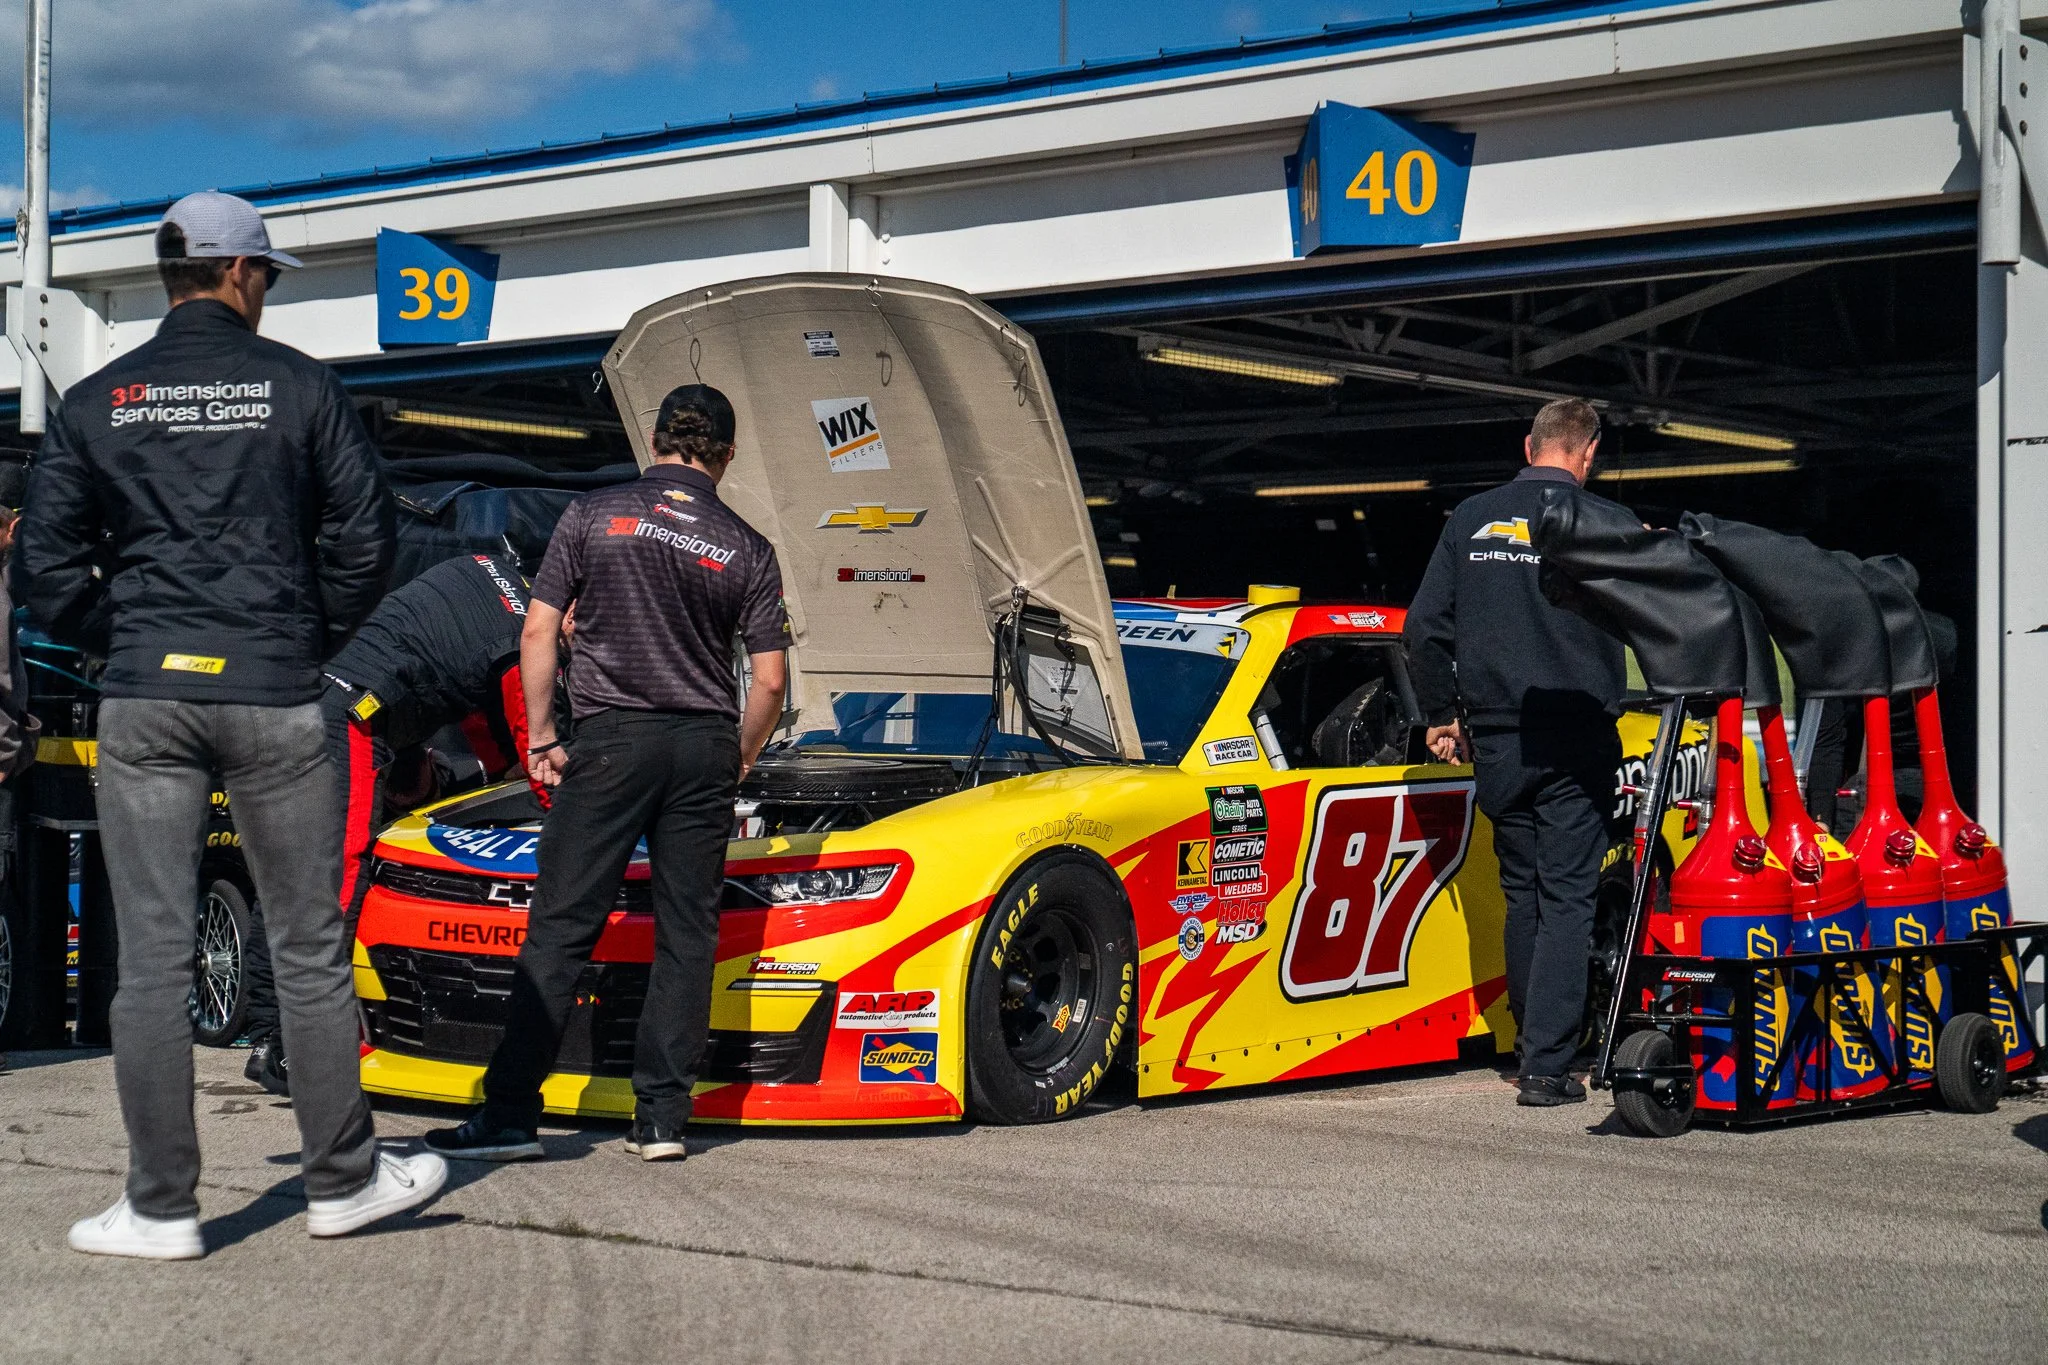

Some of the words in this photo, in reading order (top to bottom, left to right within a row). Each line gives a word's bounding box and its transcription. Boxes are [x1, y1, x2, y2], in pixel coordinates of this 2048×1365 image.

[1345, 150, 1438, 216] 40
[399, 267, 470, 321] 39
[111, 402, 200, 428] Services
[206, 401, 272, 421] Group
[818, 402, 877, 448] WIX
[831, 441, 883, 467] FILTERS
[1215, 752, 1237, 762] RACE
[1237, 750, 1253, 759] CAR
[1218, 739, 1251, 751] NASCAR
[1246, 808, 1263, 818] PARTS
[1231, 824, 1248, 833] SERIES
[442, 828, 514, 859] SEAL
[1214, 840, 1265, 859] COMETIC
[1178, 877, 1207, 886] KENNAMETAL
[1214, 867, 1258, 883] LINCOLN
[1224, 882, 1262, 896] WELDERS
[1280, 778, 1476, 1003] 87
[1217, 899, 1267, 925] Holley
[428, 920, 527, 947] CHEVRO
[991, 883, 1039, 970] EAGLE
[1216, 922, 1260, 944] MSD
[756, 962, 820, 971] PETERSON
[841, 991, 935, 1013] ARP
[839, 1013, 883, 1021] automotive
[904, 1011, 936, 1020] products
[865, 1051, 932, 1065] SUNOCO
